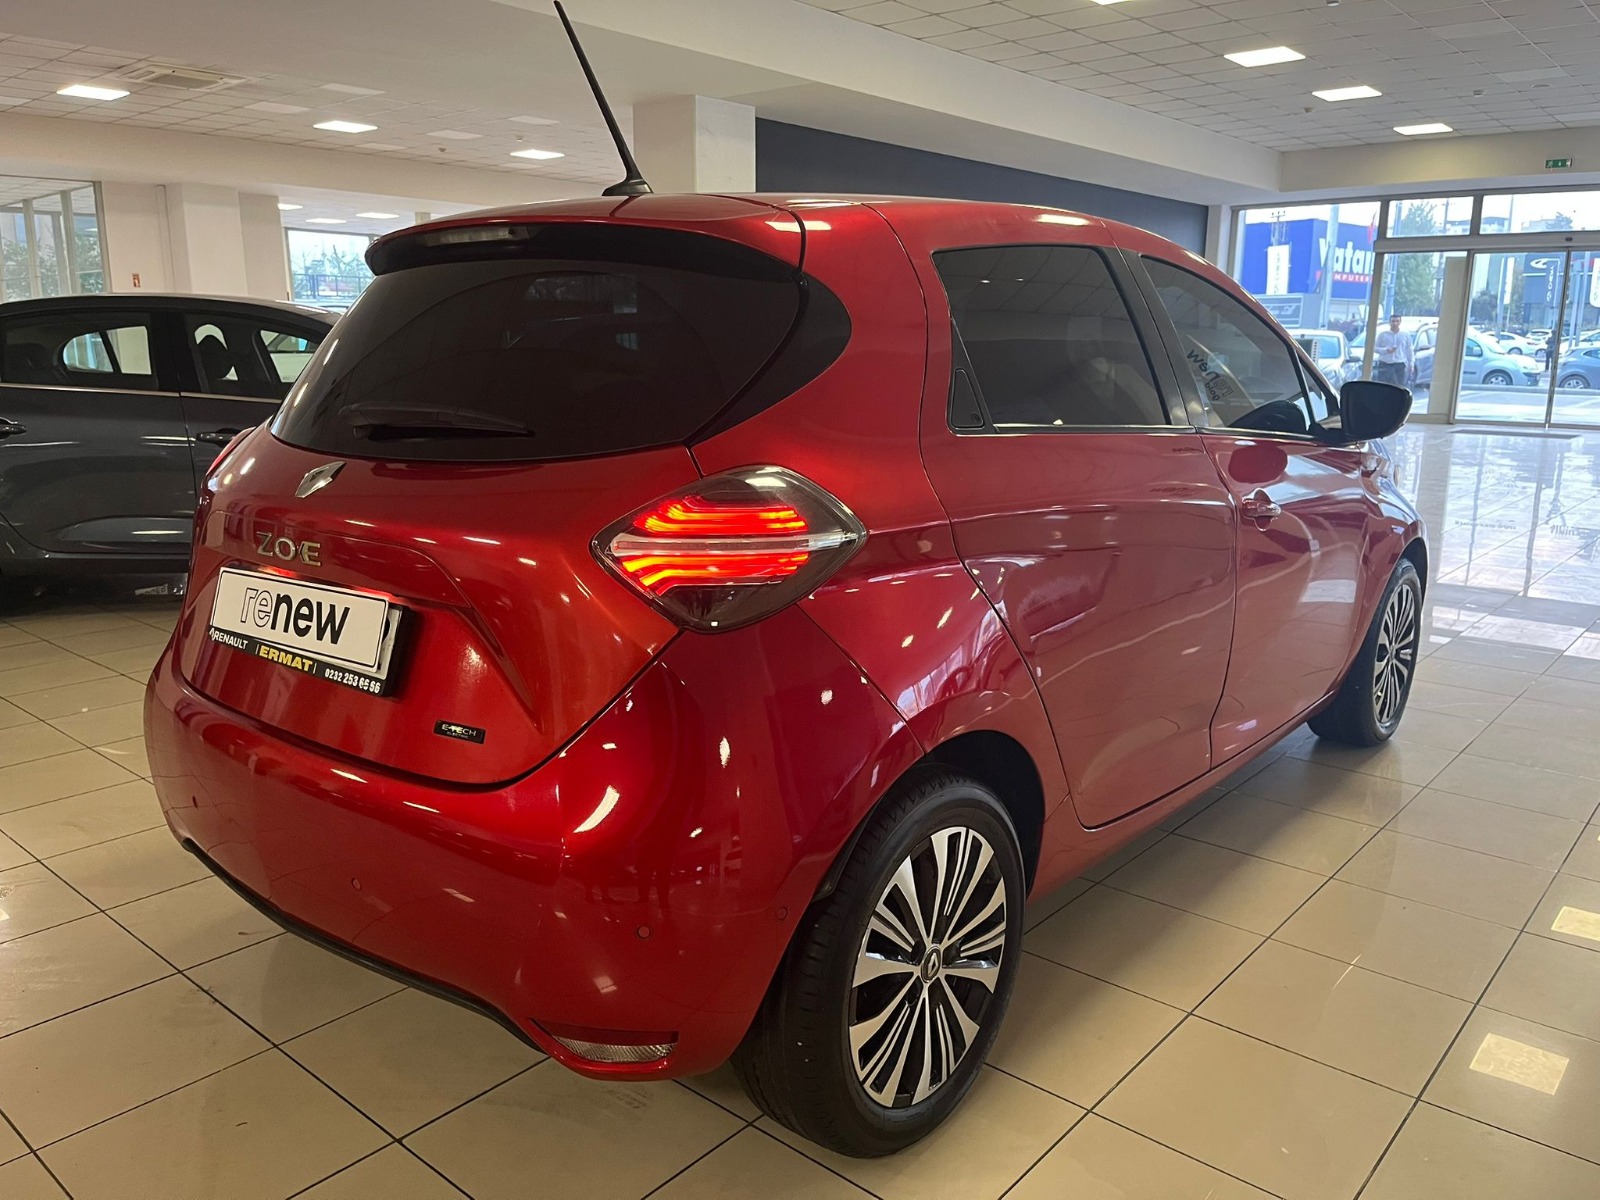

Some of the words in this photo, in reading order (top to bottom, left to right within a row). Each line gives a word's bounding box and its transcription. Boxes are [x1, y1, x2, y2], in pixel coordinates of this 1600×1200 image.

[256, 531, 322, 567] ZOE
[240, 587, 350, 645] renew
[214, 631, 248, 650] RENAULT
[258, 645, 313, 673] ERMAT
[324, 668, 343, 682] 0232
[342, 672, 359, 687] 253
